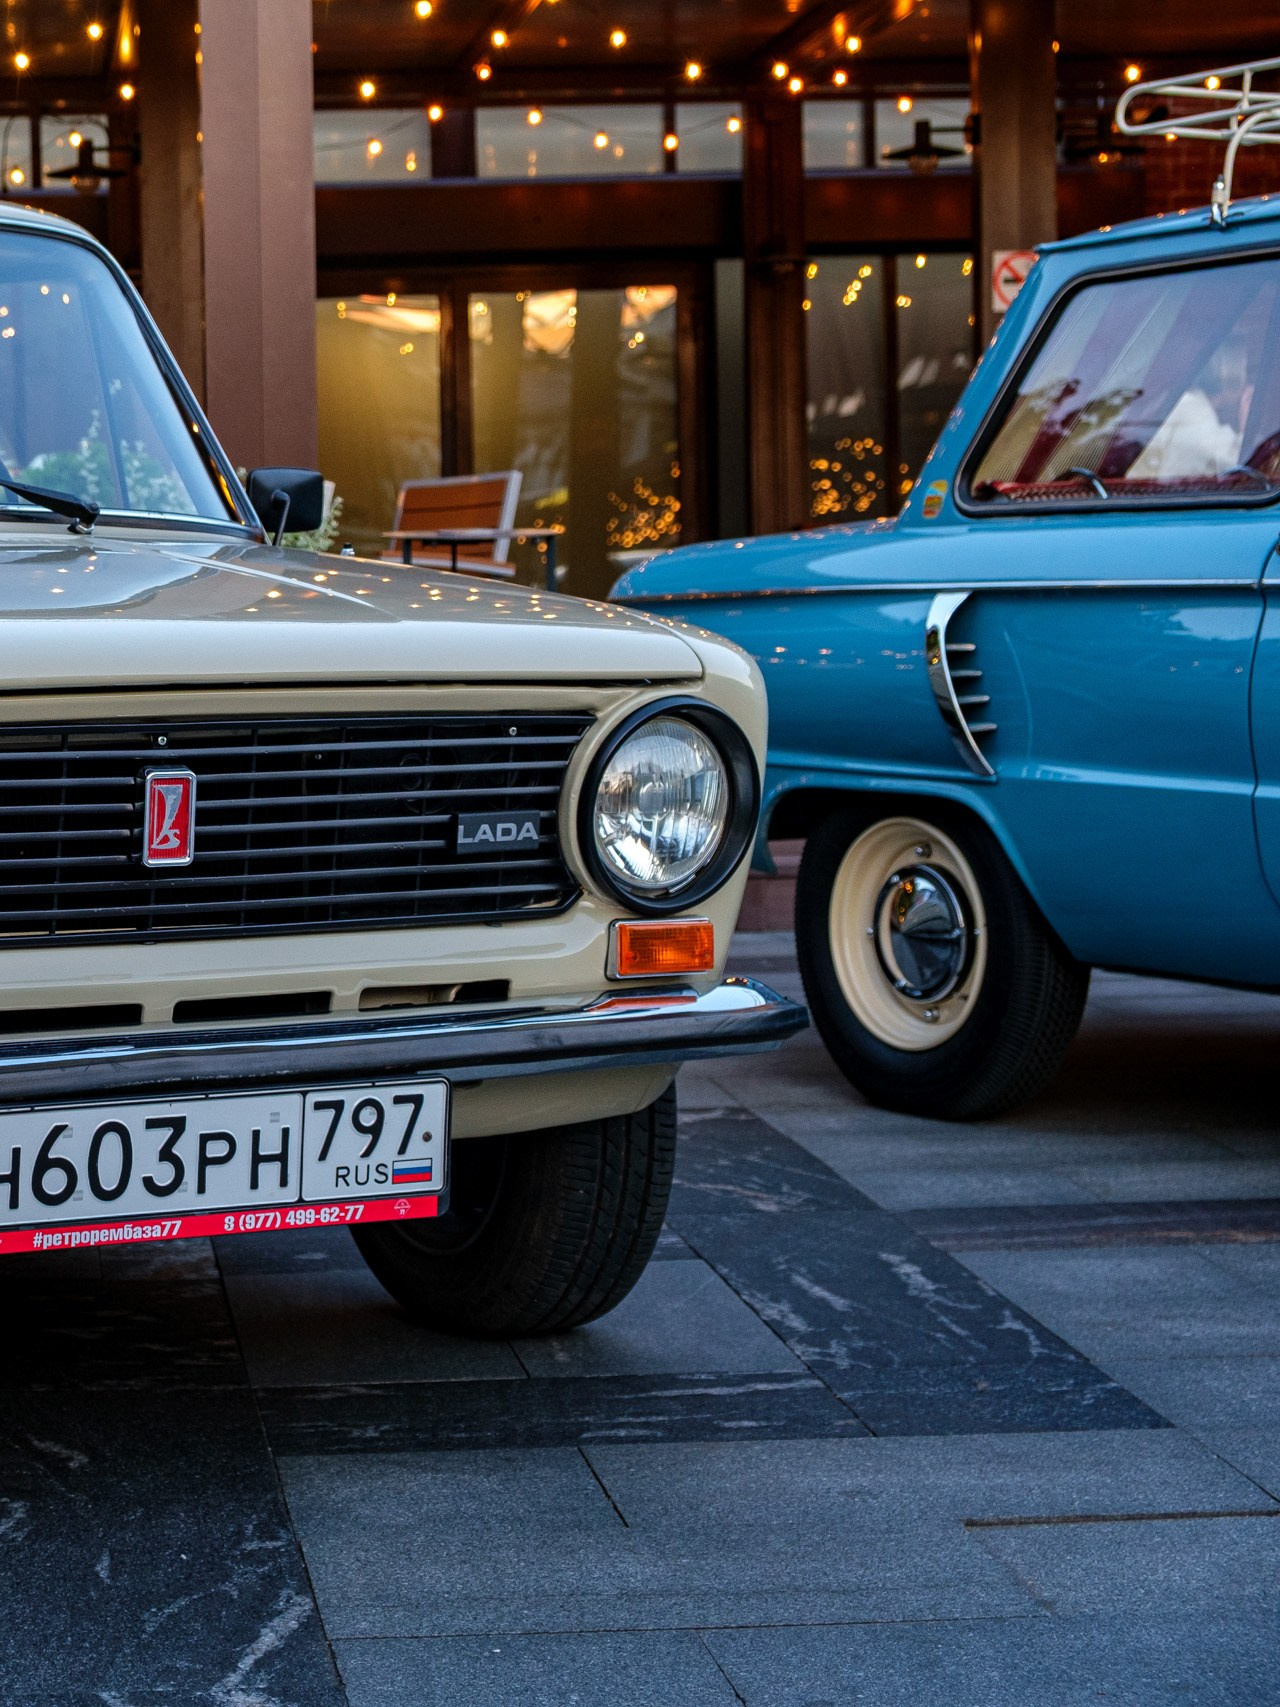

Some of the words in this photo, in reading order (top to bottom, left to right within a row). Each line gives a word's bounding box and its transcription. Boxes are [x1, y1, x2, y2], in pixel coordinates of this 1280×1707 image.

[457, 821, 539, 844] LADA
[313, 1093, 424, 1162] 797
[335, 1163, 389, 1188] RUS
[224, 1215, 234, 1231] 8
[239, 1211, 281, 1231] (977)
[285, 1204, 365, 1226] 499-62-77
[33, 1220, 182, 1249] #ретрорембаза77
